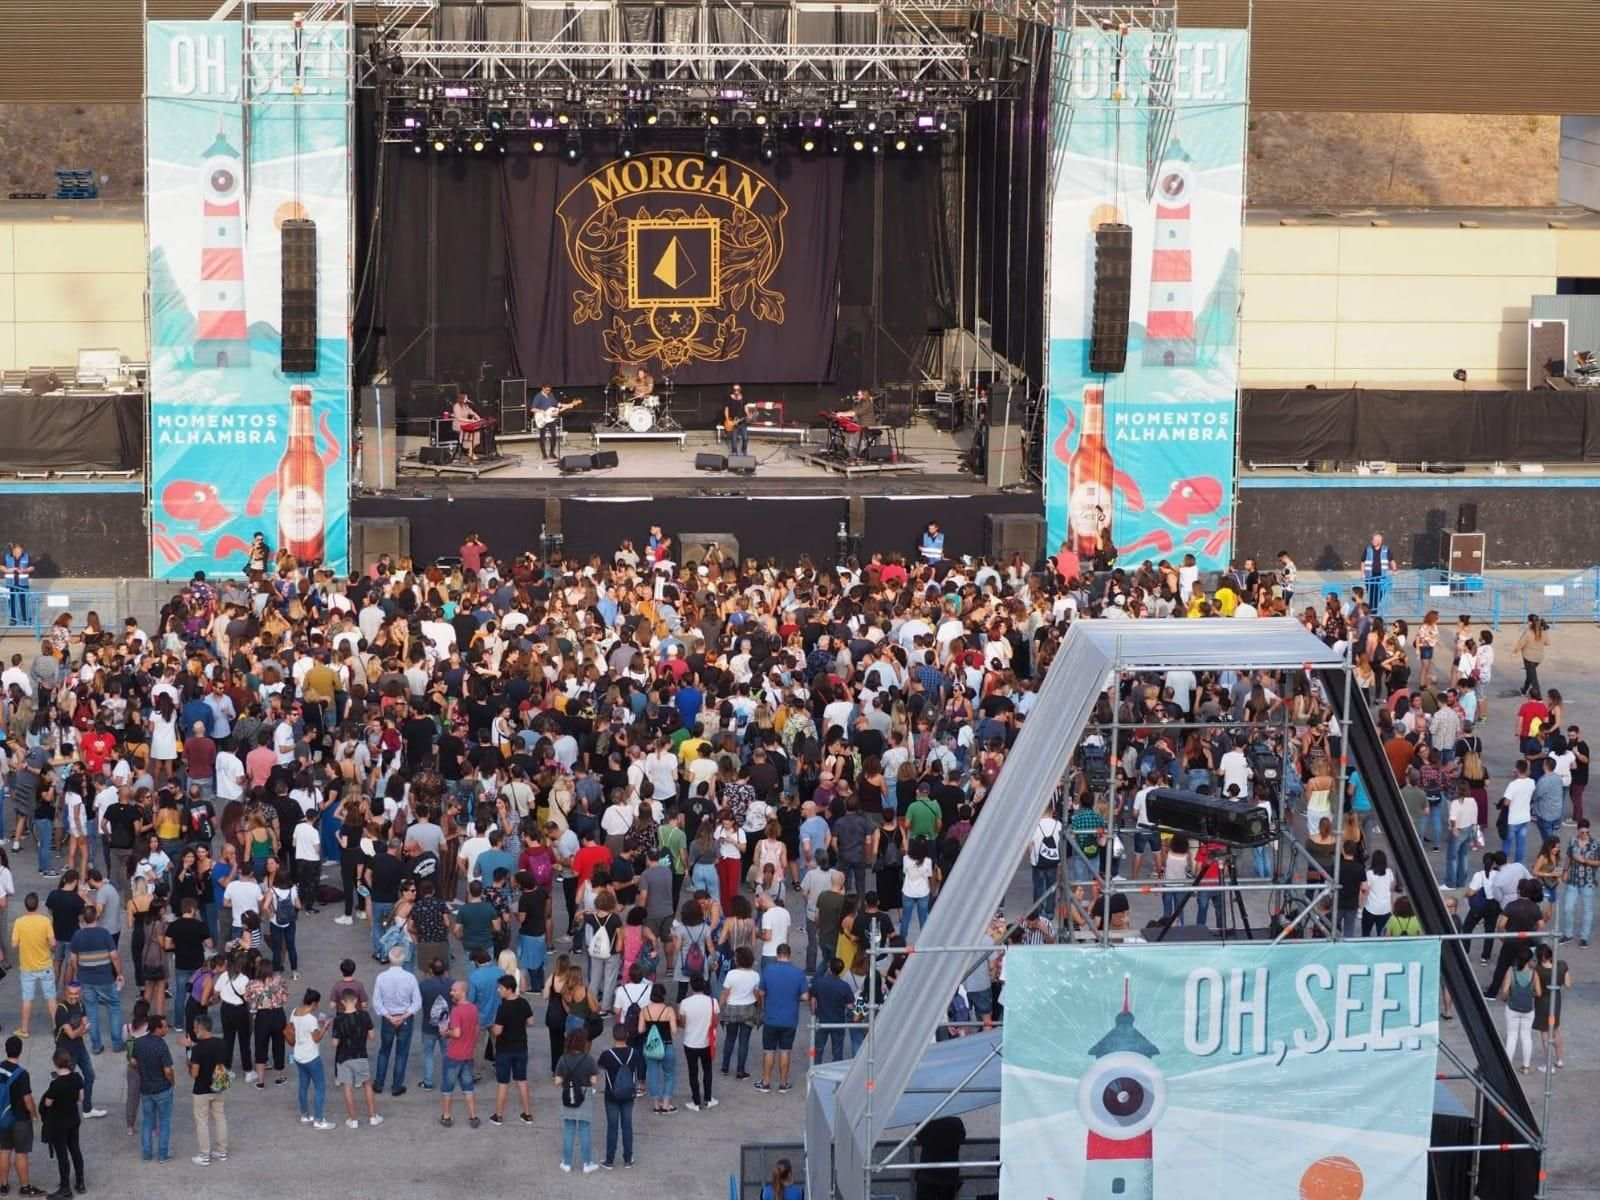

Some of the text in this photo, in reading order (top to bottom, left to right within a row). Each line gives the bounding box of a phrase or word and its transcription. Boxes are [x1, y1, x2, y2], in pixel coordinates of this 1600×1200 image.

[169, 34, 241, 101] OH,
[589, 157, 766, 208] MORGAN
[158, 414, 278, 428] MOMENTOS
[1115, 412, 1229, 425] MOMENTOS
[159, 430, 277, 444] ALHAMBRA
[1115, 428, 1228, 441] ALHAMBRA
[1184, 961, 1424, 1066] OH, SEE!
